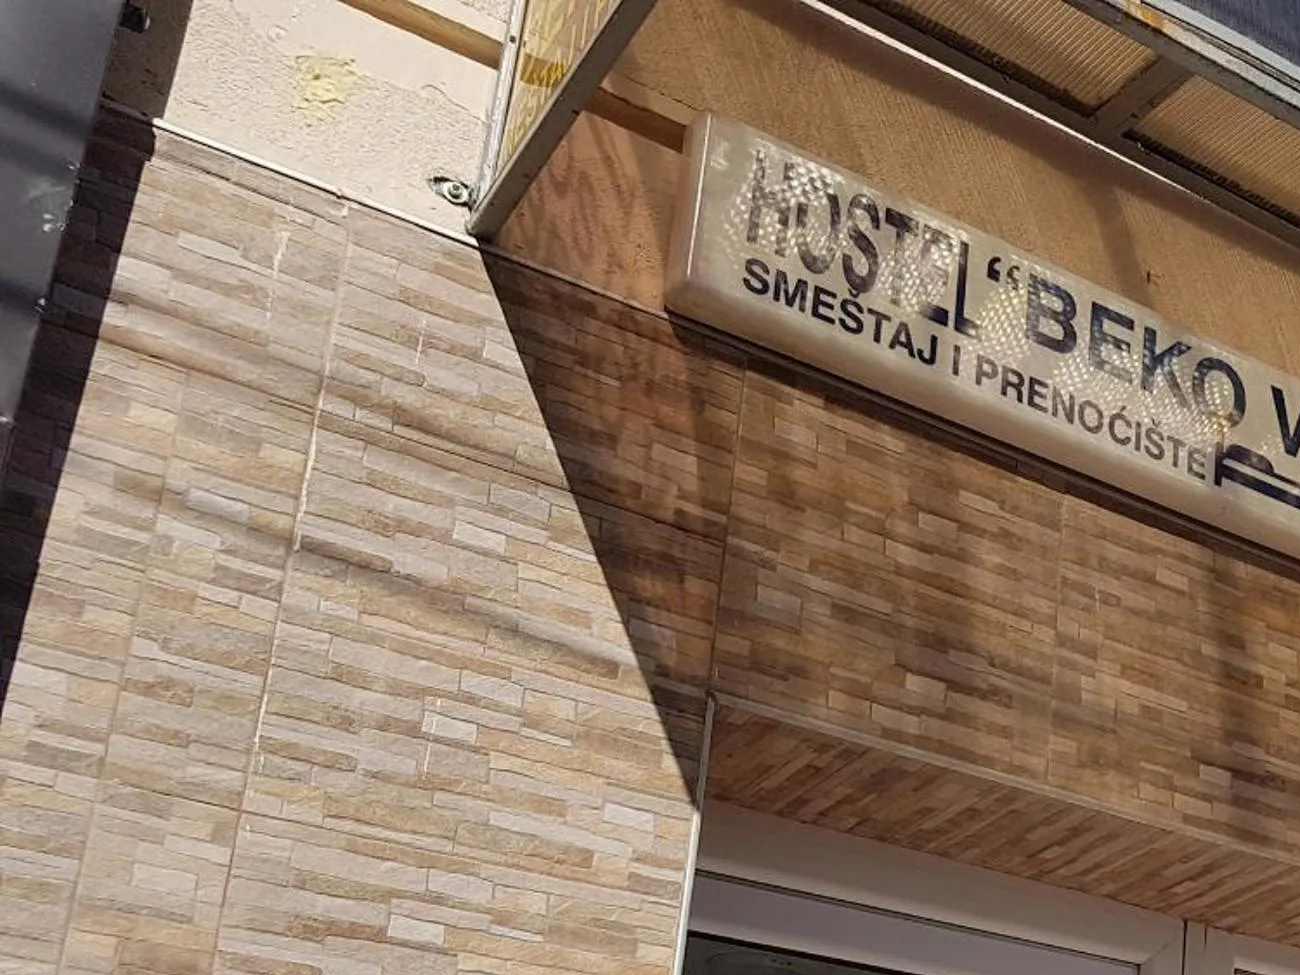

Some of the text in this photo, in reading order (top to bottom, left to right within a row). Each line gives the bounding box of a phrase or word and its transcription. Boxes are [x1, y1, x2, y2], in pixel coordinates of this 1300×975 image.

[742, 257, 1206, 481] SMEŠTAJ I PRENOĆIŠTE
